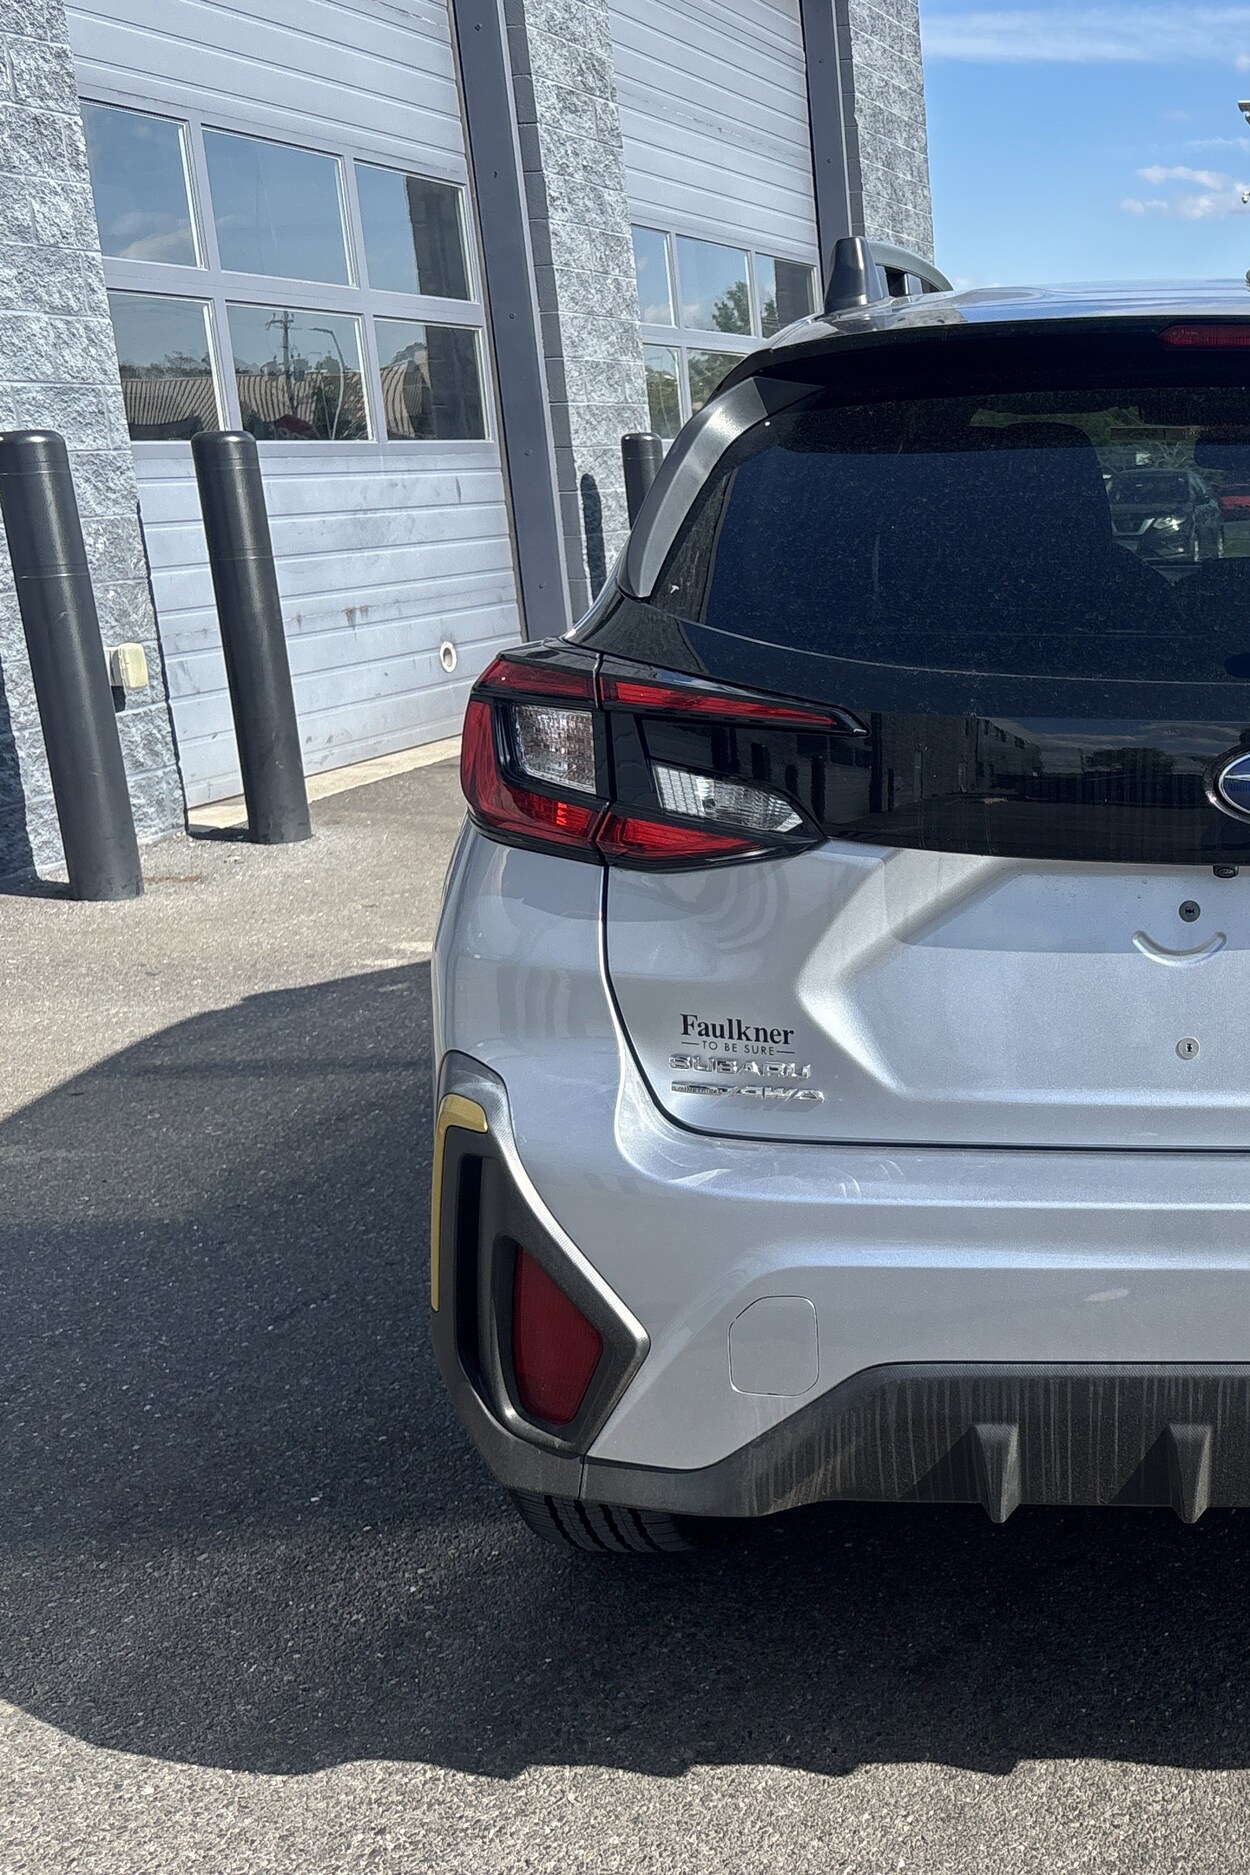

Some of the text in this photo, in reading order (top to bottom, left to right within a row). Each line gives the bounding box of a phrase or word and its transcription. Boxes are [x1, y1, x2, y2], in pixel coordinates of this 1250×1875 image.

[680, 1013, 795, 1045] Faulkner
[701, 1040, 775, 1056] TO BE SURE
[668, 1053, 812, 1079] SUBARU
